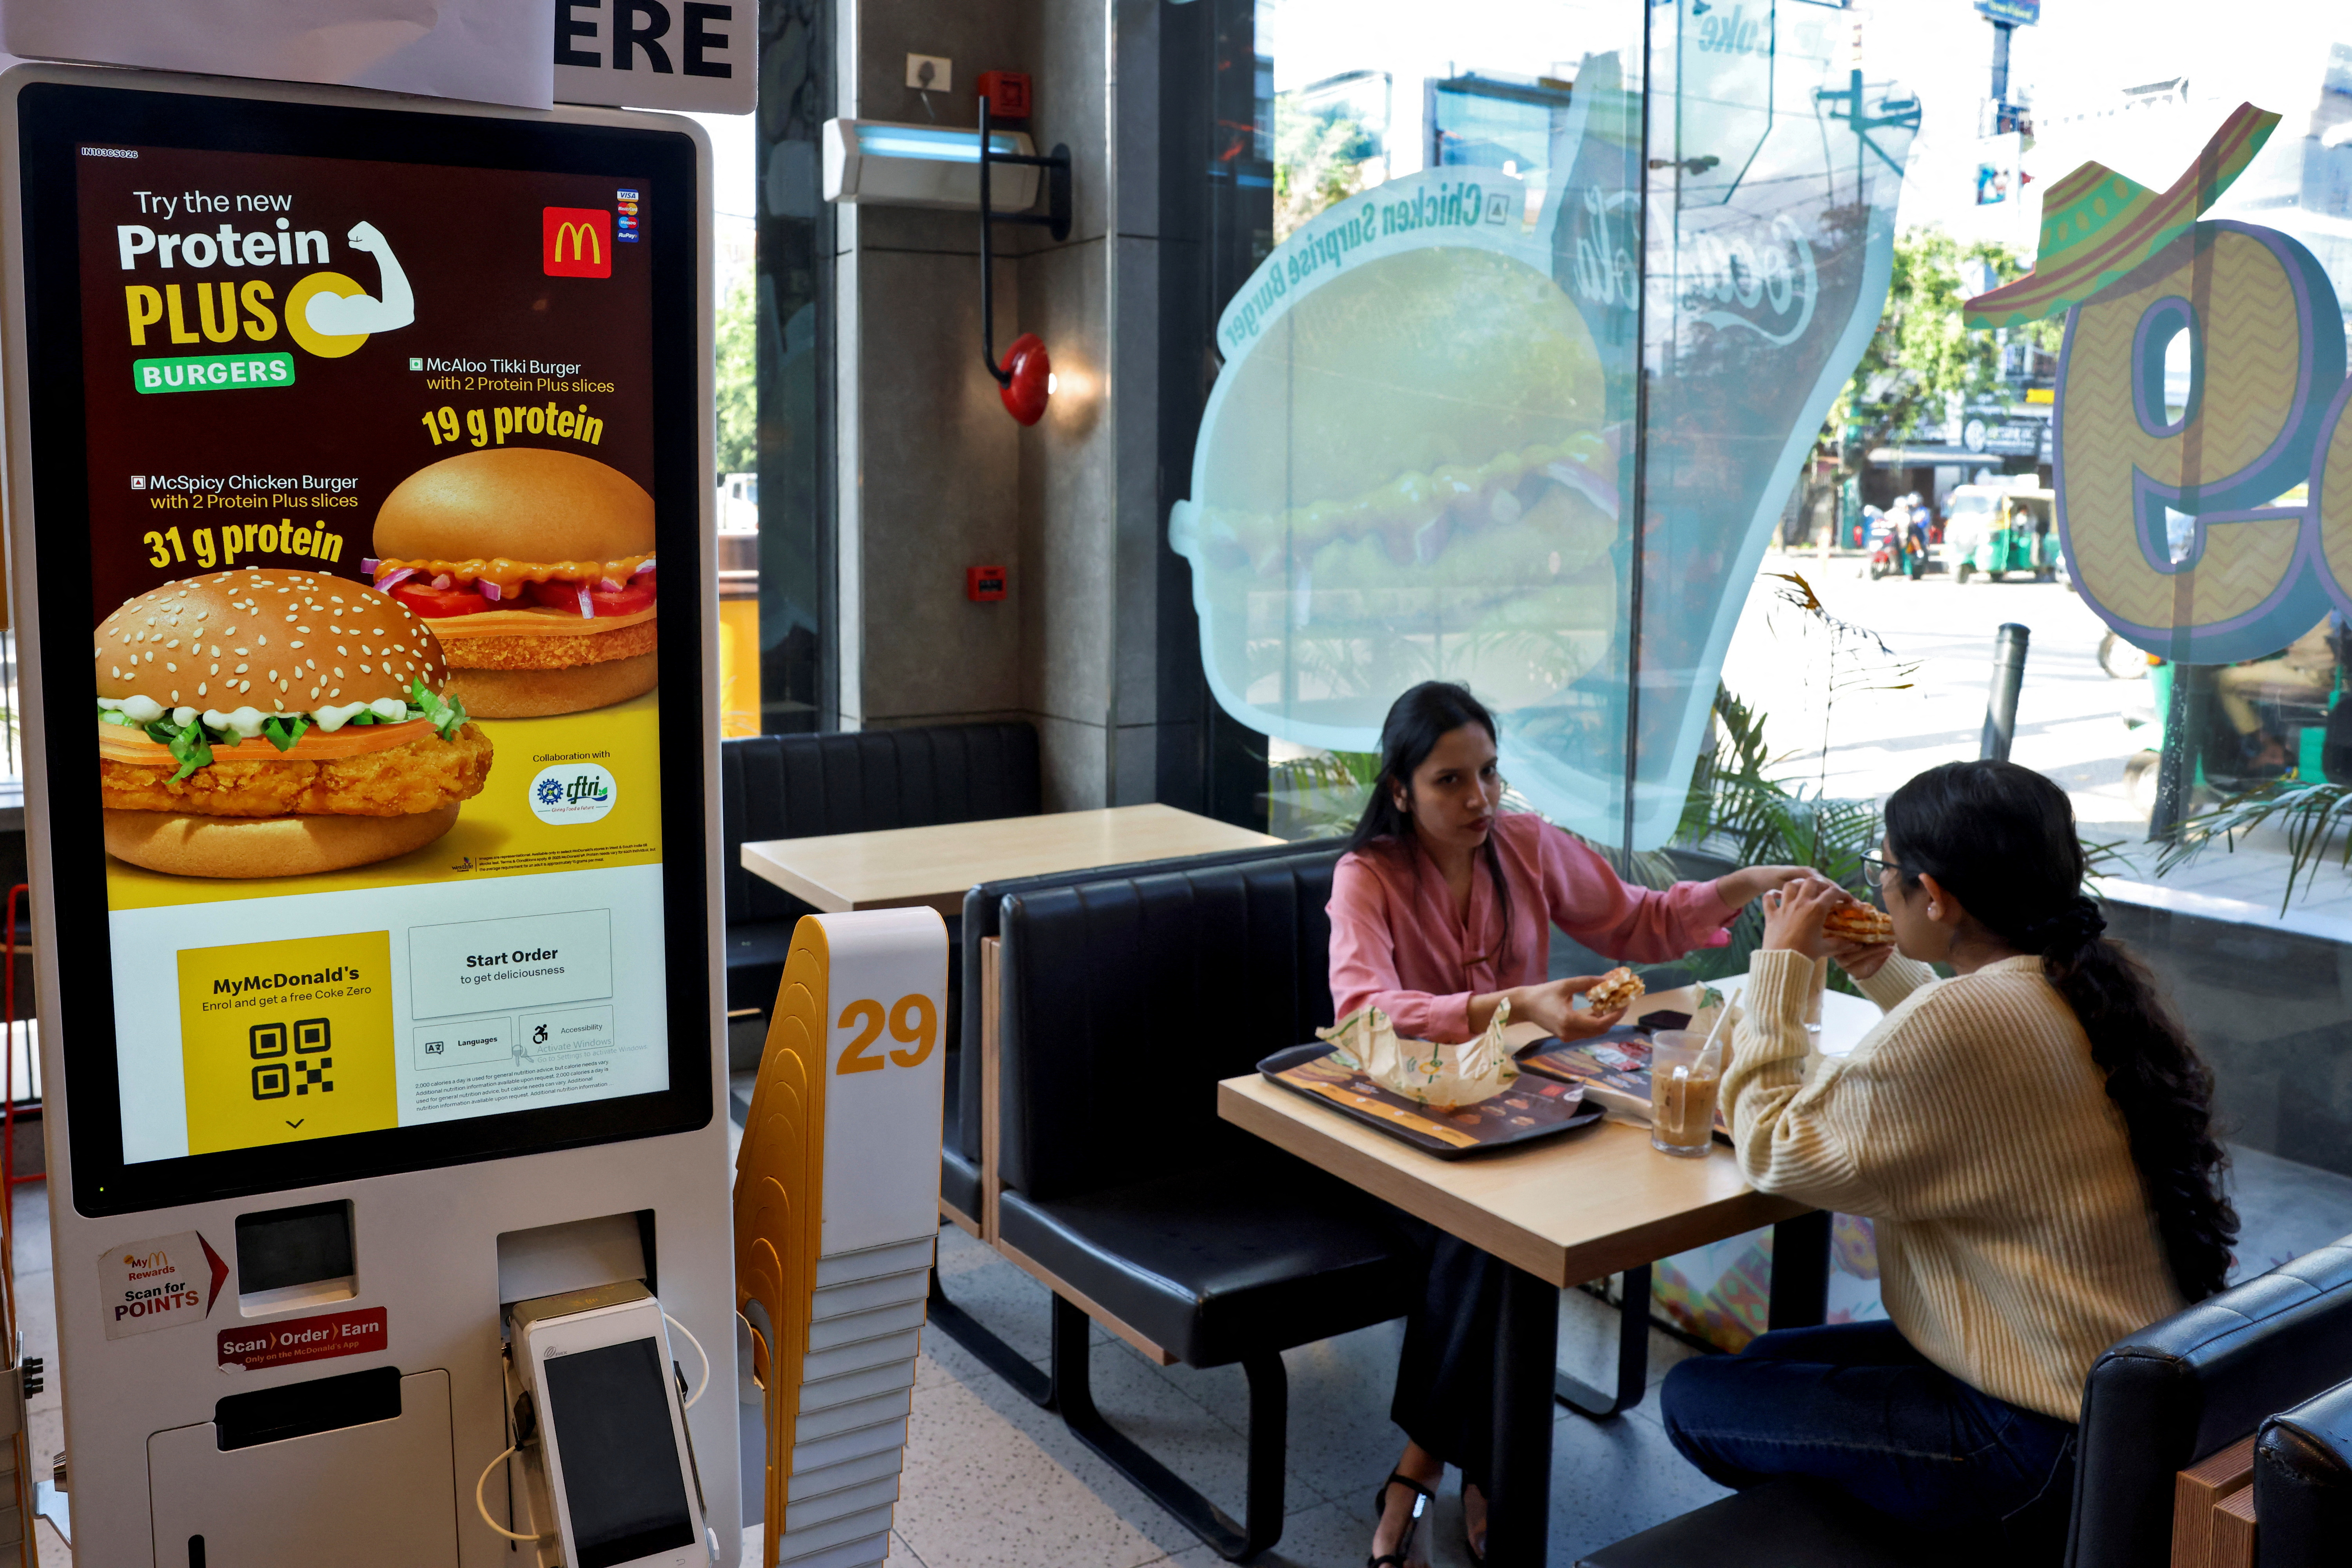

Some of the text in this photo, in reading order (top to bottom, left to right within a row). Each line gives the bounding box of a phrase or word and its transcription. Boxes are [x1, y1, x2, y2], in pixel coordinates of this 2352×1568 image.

[133, 190, 292, 220] Try the new
[117, 218, 330, 270] Protein
[125, 280, 278, 346] PLUS
[143, 359, 287, 388] BURGERS
[426, 358, 581, 377] McAloo Tikki Burger
[426, 376, 614, 393] with 2 Protein Plus slices
[422, 401, 604, 447] 19 g protein
[150, 475, 358, 493] McSpicy Chicken Burger
[151, 493, 358, 509] with 2 Protein Plus slices
[143, 519, 343, 568] 31 g protein
[533, 752, 590, 762] Collaboration
[566, 776, 599, 804] cftri
[466, 947, 558, 968] Start Order
[213, 966, 359, 996] MyMcDonald's
[461, 966, 565, 985] to get deliciousness
[202, 1000, 232, 1011] Enrol
[235, 996, 256, 1008] and
[259, 995, 278, 1007] get
[290, 992, 312, 1002] free
[315, 989, 344, 1000] Coke
[346, 985, 372, 996] Zero
[561, 1024, 603, 1034] Accessibility
[836, 994, 937, 1075] 29
[458, 1037, 497, 1046] Languages
[537, 1038, 612, 1053] Activate Windows
[129, 1266, 175, 1281] Rewards
[132, 1259, 147, 1268] My
[125, 1282, 185, 1301] Scan for
[115, 1290, 199, 1321] POINTS
[223, 1322, 379, 1354] Scan Order Earn
[245, 1355, 264, 1363] Only
[294, 1343, 341, 1356] McDonald's
